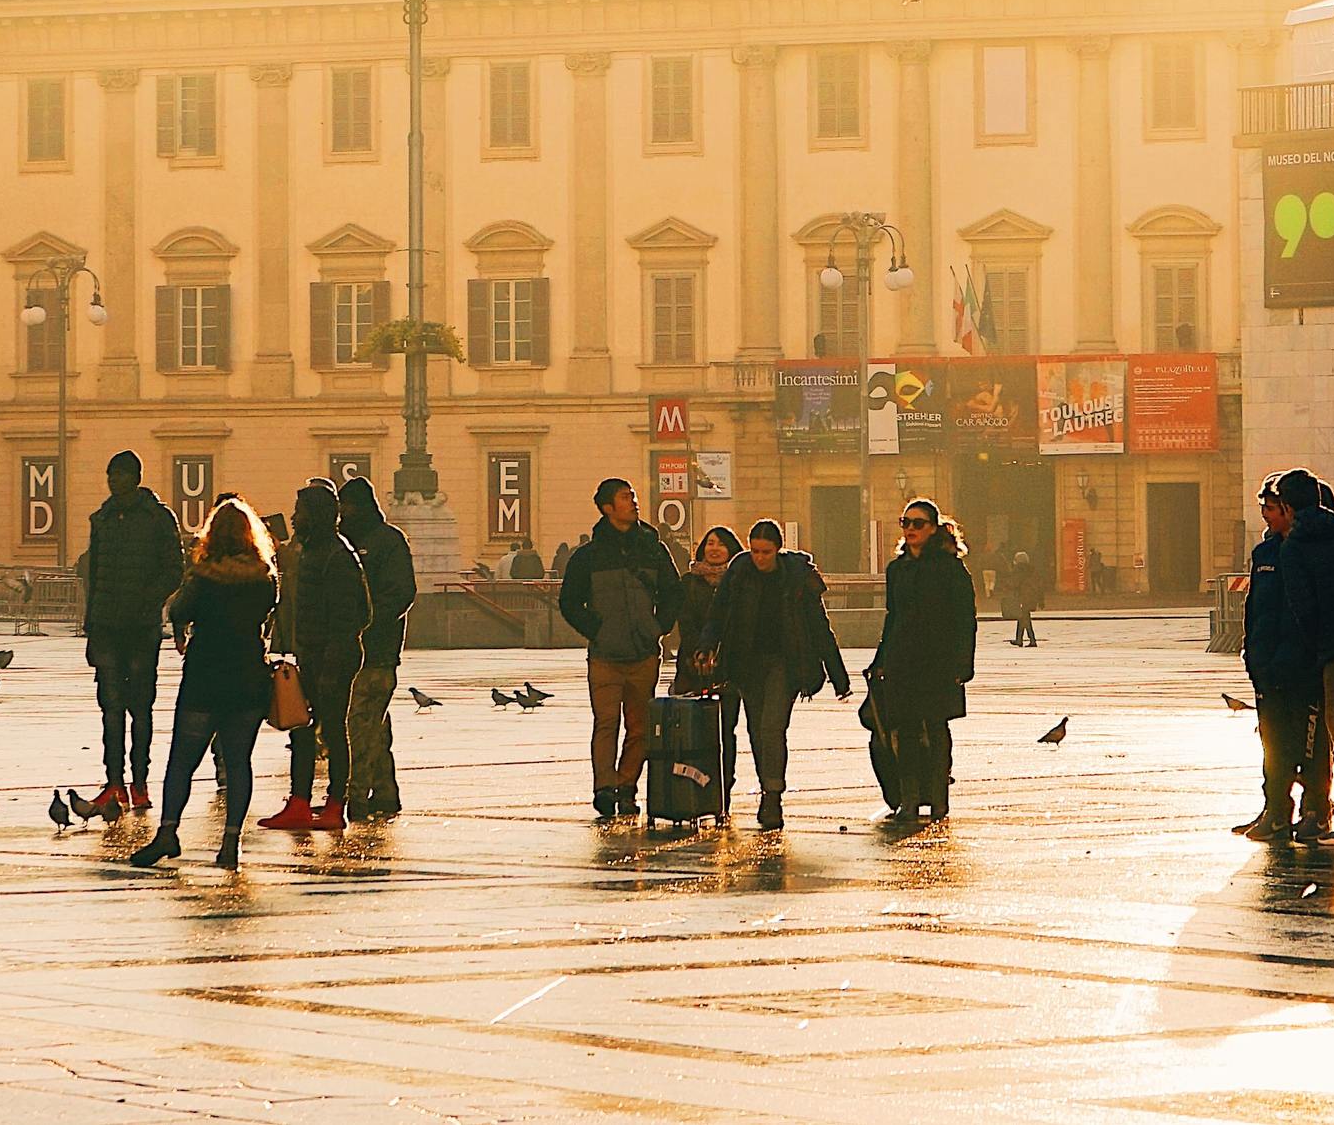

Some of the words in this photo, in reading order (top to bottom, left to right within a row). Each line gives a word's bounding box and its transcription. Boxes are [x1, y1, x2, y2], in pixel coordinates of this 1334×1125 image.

[1268, 154, 1301, 166] MUSEO
[1303, 153, 1321, 164] DEL
[778, 370, 859, 386] Incantesimi
[657, 406, 685, 432] M
[1040, 394, 1124, 424] TOULOUSE
[29, 465, 54, 498] M
[181, 463, 205, 497] U
[499, 461, 519, 495] E
[29, 501, 53, 535] D
[498, 498, 520, 532] M
